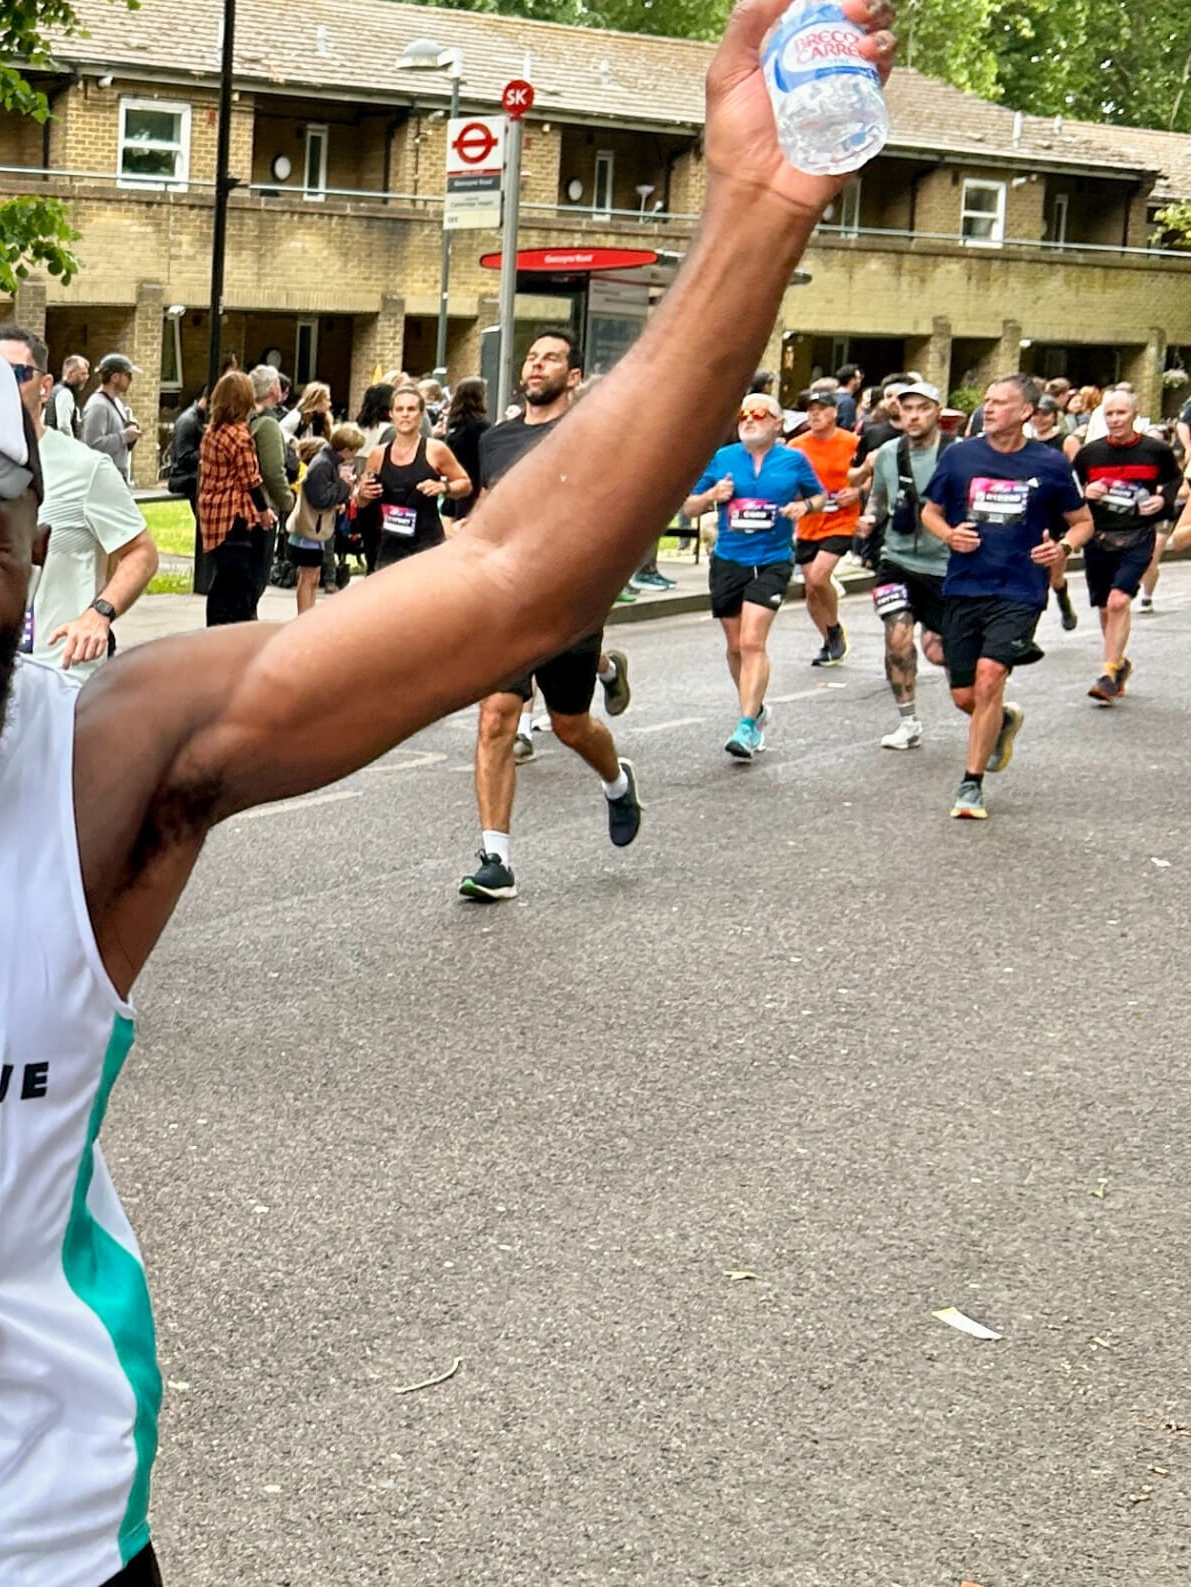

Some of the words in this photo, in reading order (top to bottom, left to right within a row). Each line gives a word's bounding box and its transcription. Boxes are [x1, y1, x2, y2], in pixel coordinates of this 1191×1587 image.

[794, 30, 859, 52] BRECO
[796, 42, 859, 64] CARRE
[506, 89, 527, 105] SK
